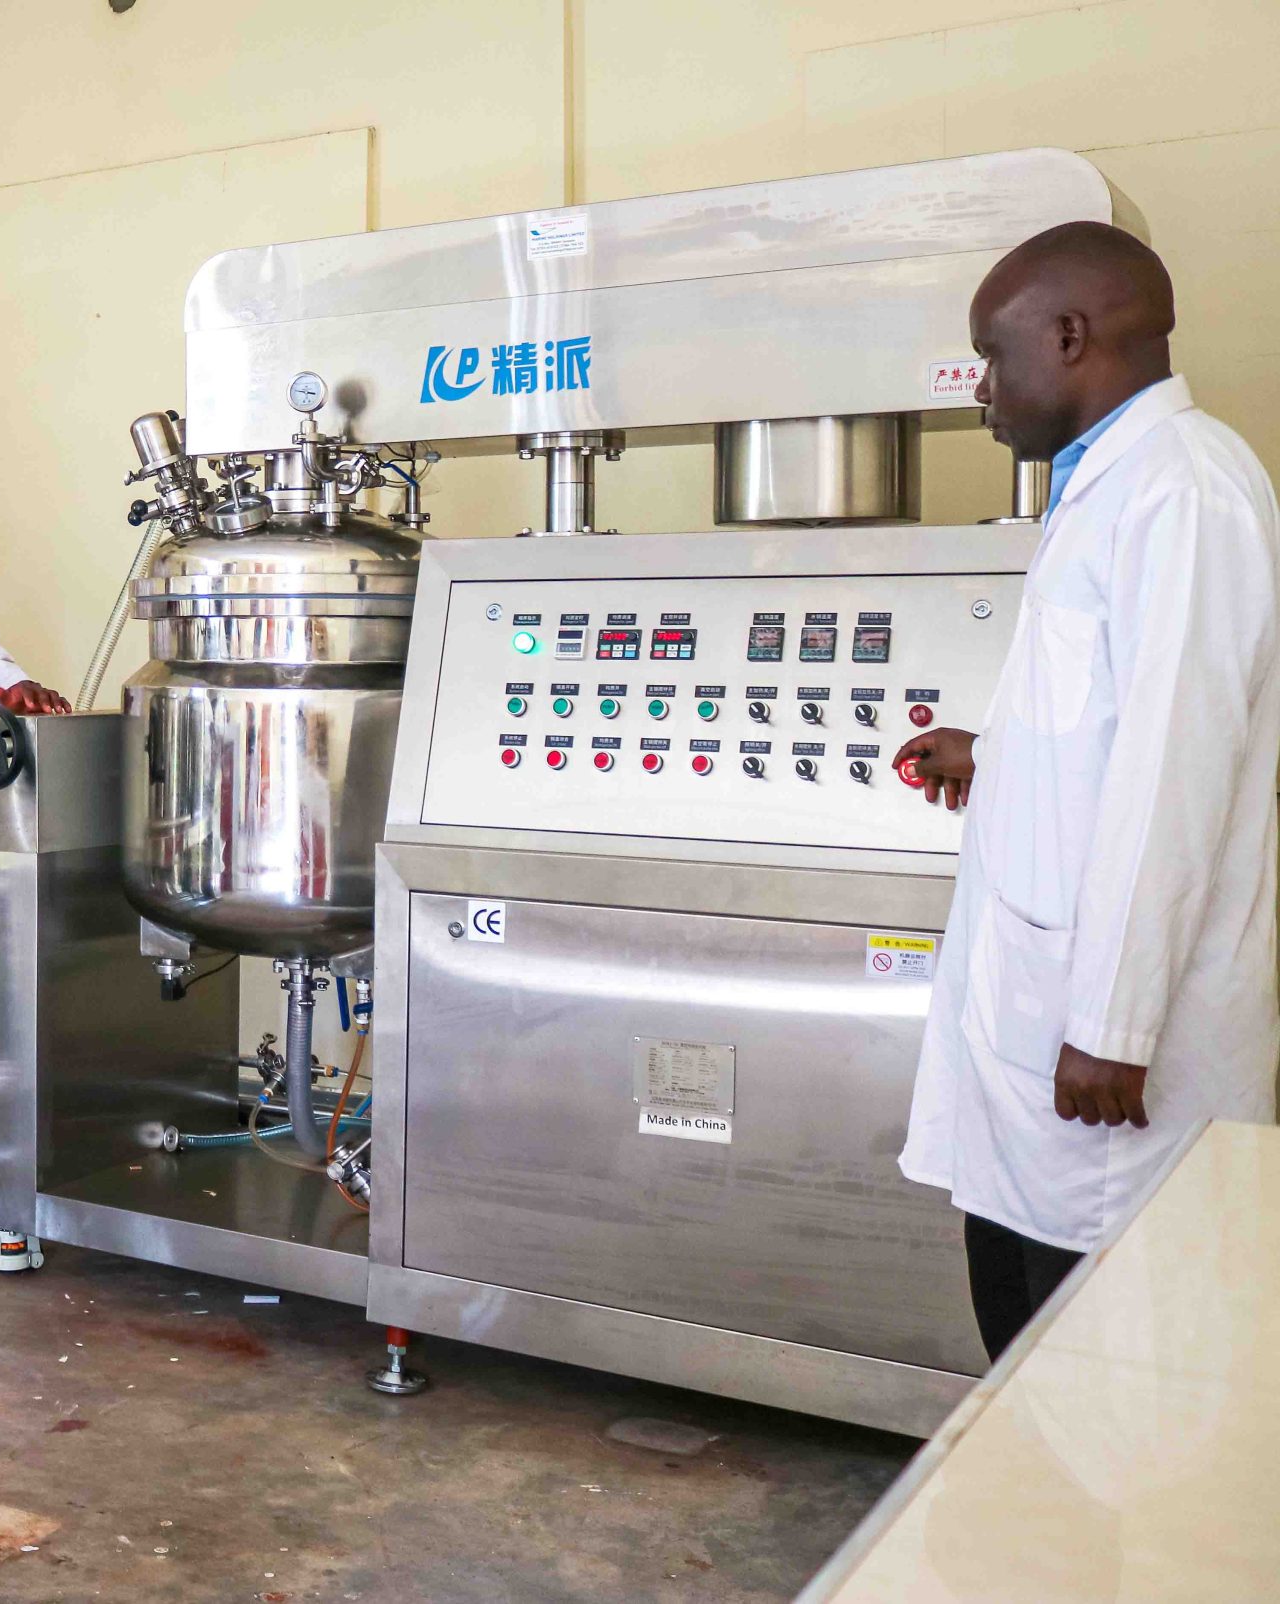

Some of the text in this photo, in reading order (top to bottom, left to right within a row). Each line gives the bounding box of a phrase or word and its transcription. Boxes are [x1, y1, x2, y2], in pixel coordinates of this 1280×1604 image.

[491, 335, 591, 396] 精派
[934, 366, 986, 383] 严禁在
[934, 383, 963, 393] Forbid
[473, 908, 500, 935] CE
[647, 1114, 726, 1131] Made in China
